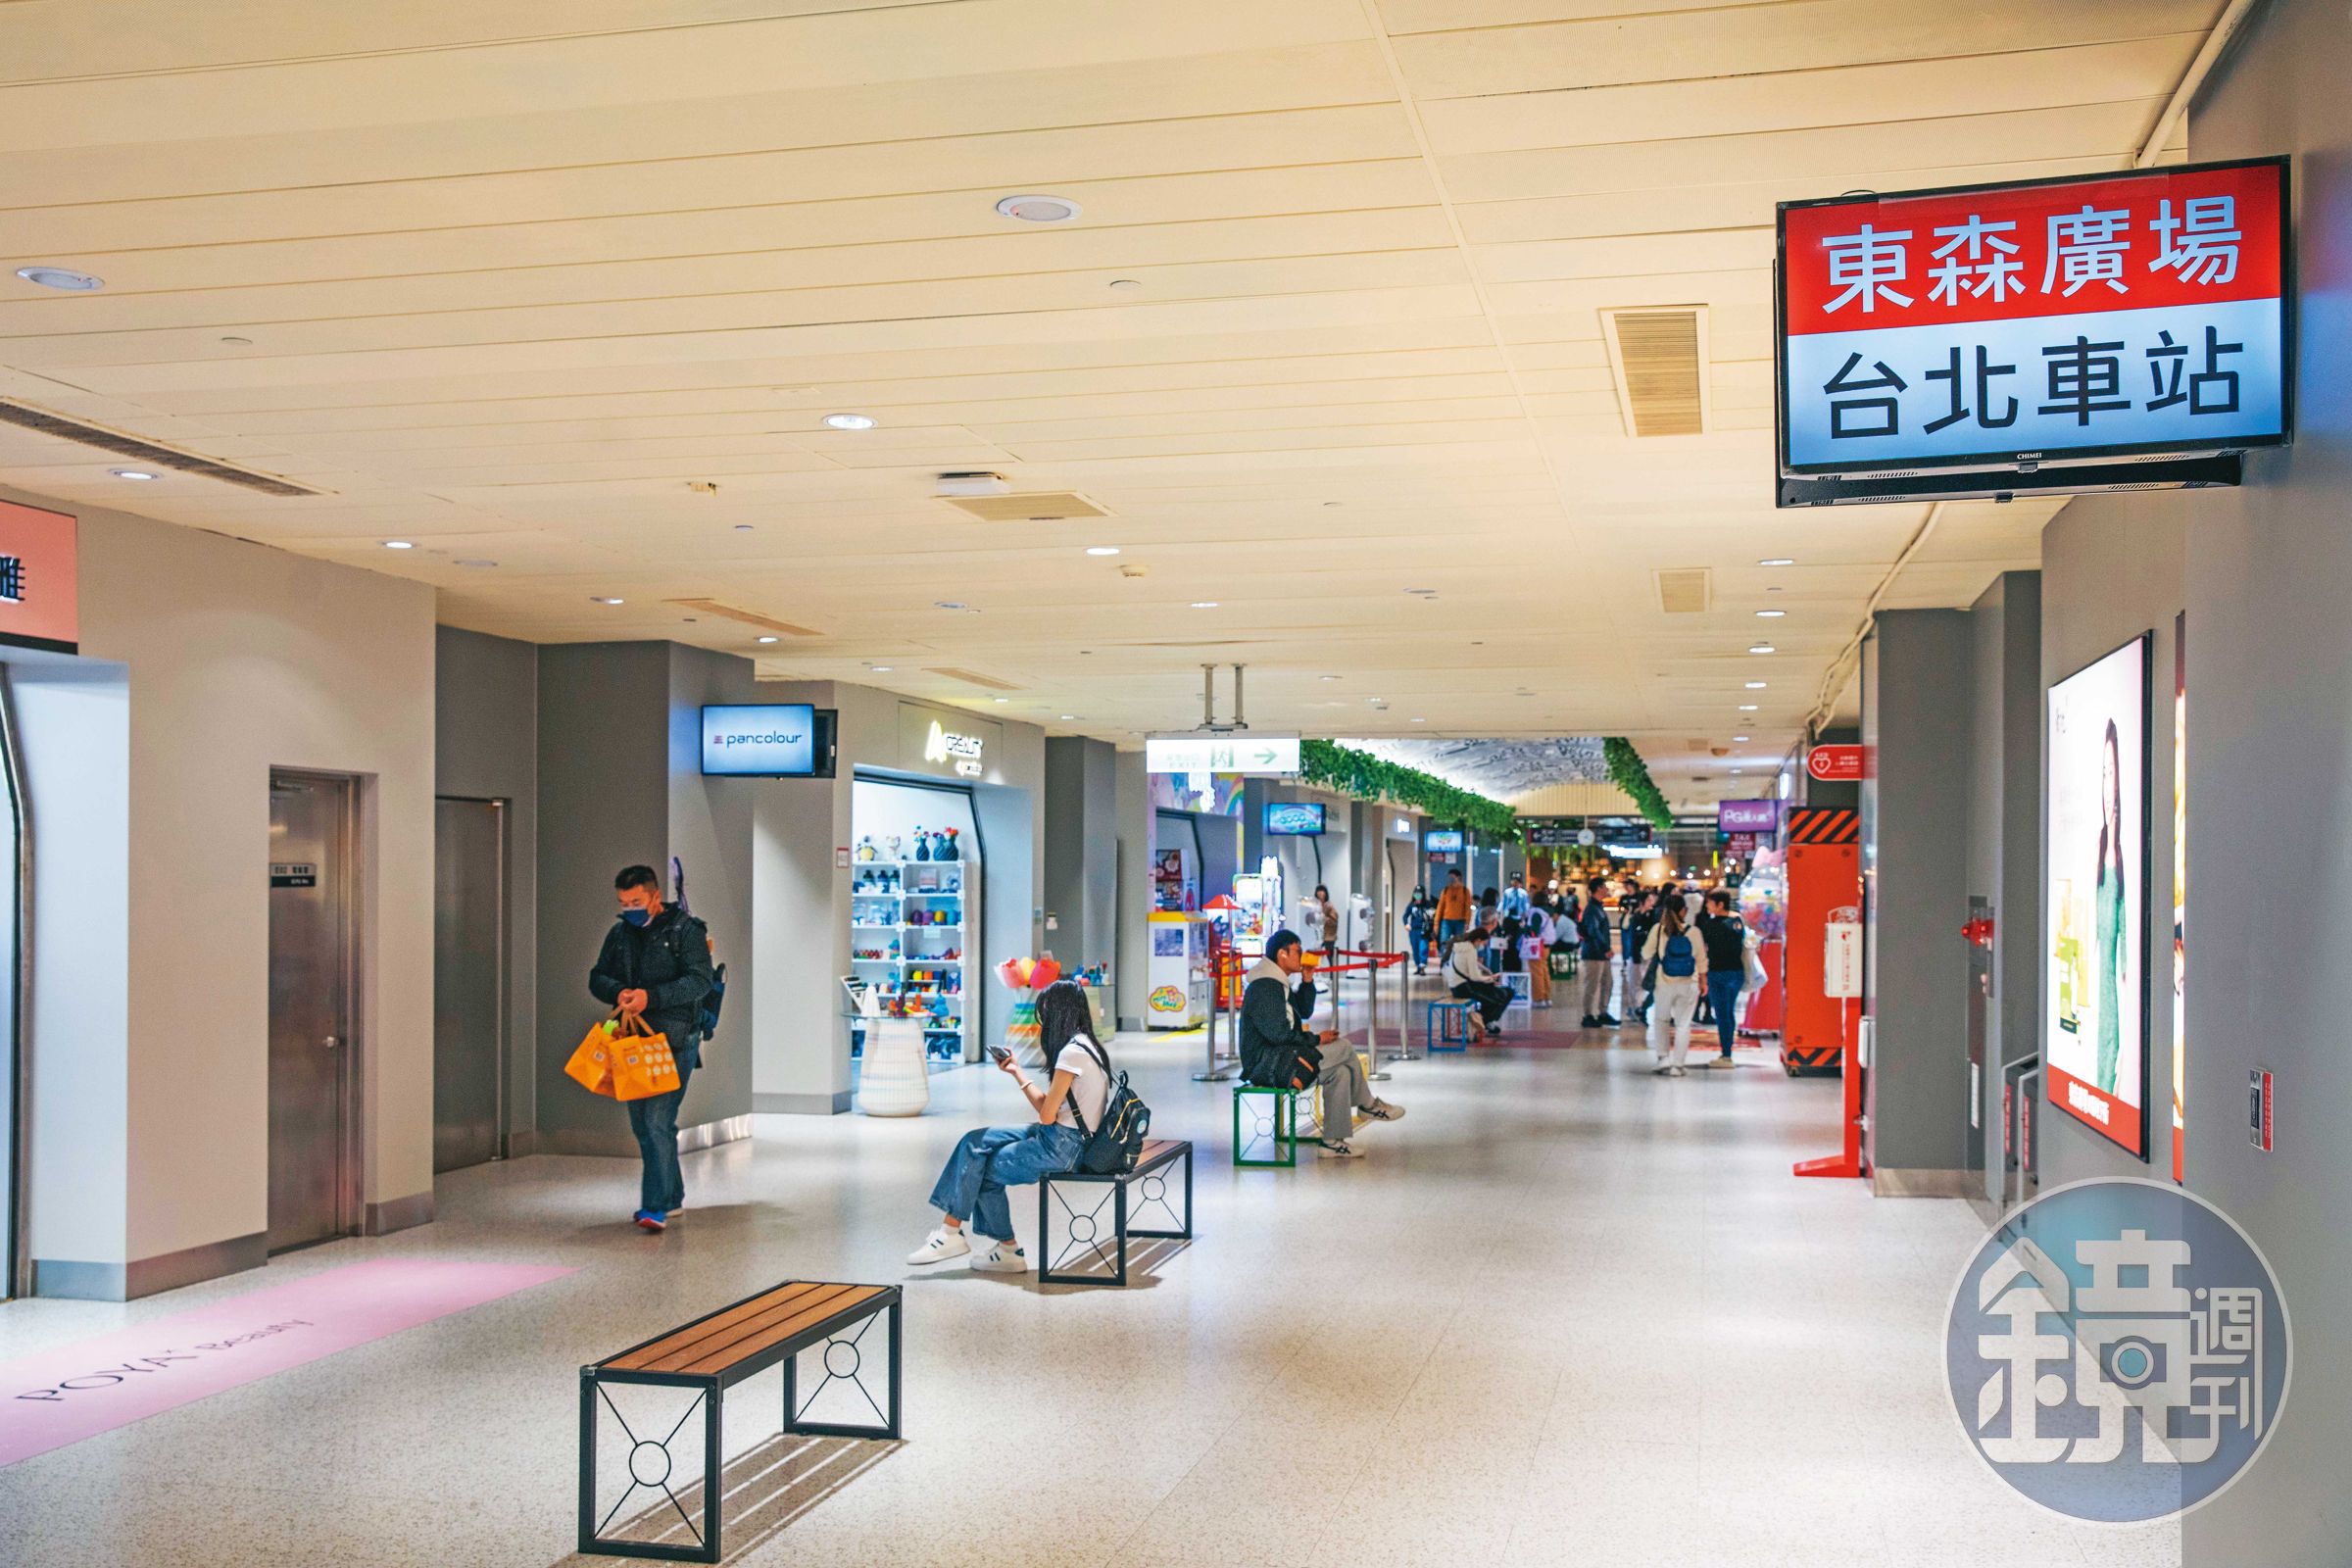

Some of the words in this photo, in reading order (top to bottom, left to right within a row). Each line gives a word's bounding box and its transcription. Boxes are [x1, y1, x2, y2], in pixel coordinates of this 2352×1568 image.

[1822, 195, 2242, 314] 東森廣場
[1823, 325, 2243, 440] 台北車站
[727, 731, 803, 748] pancolour
[15, 1354, 199, 1401] POYA
